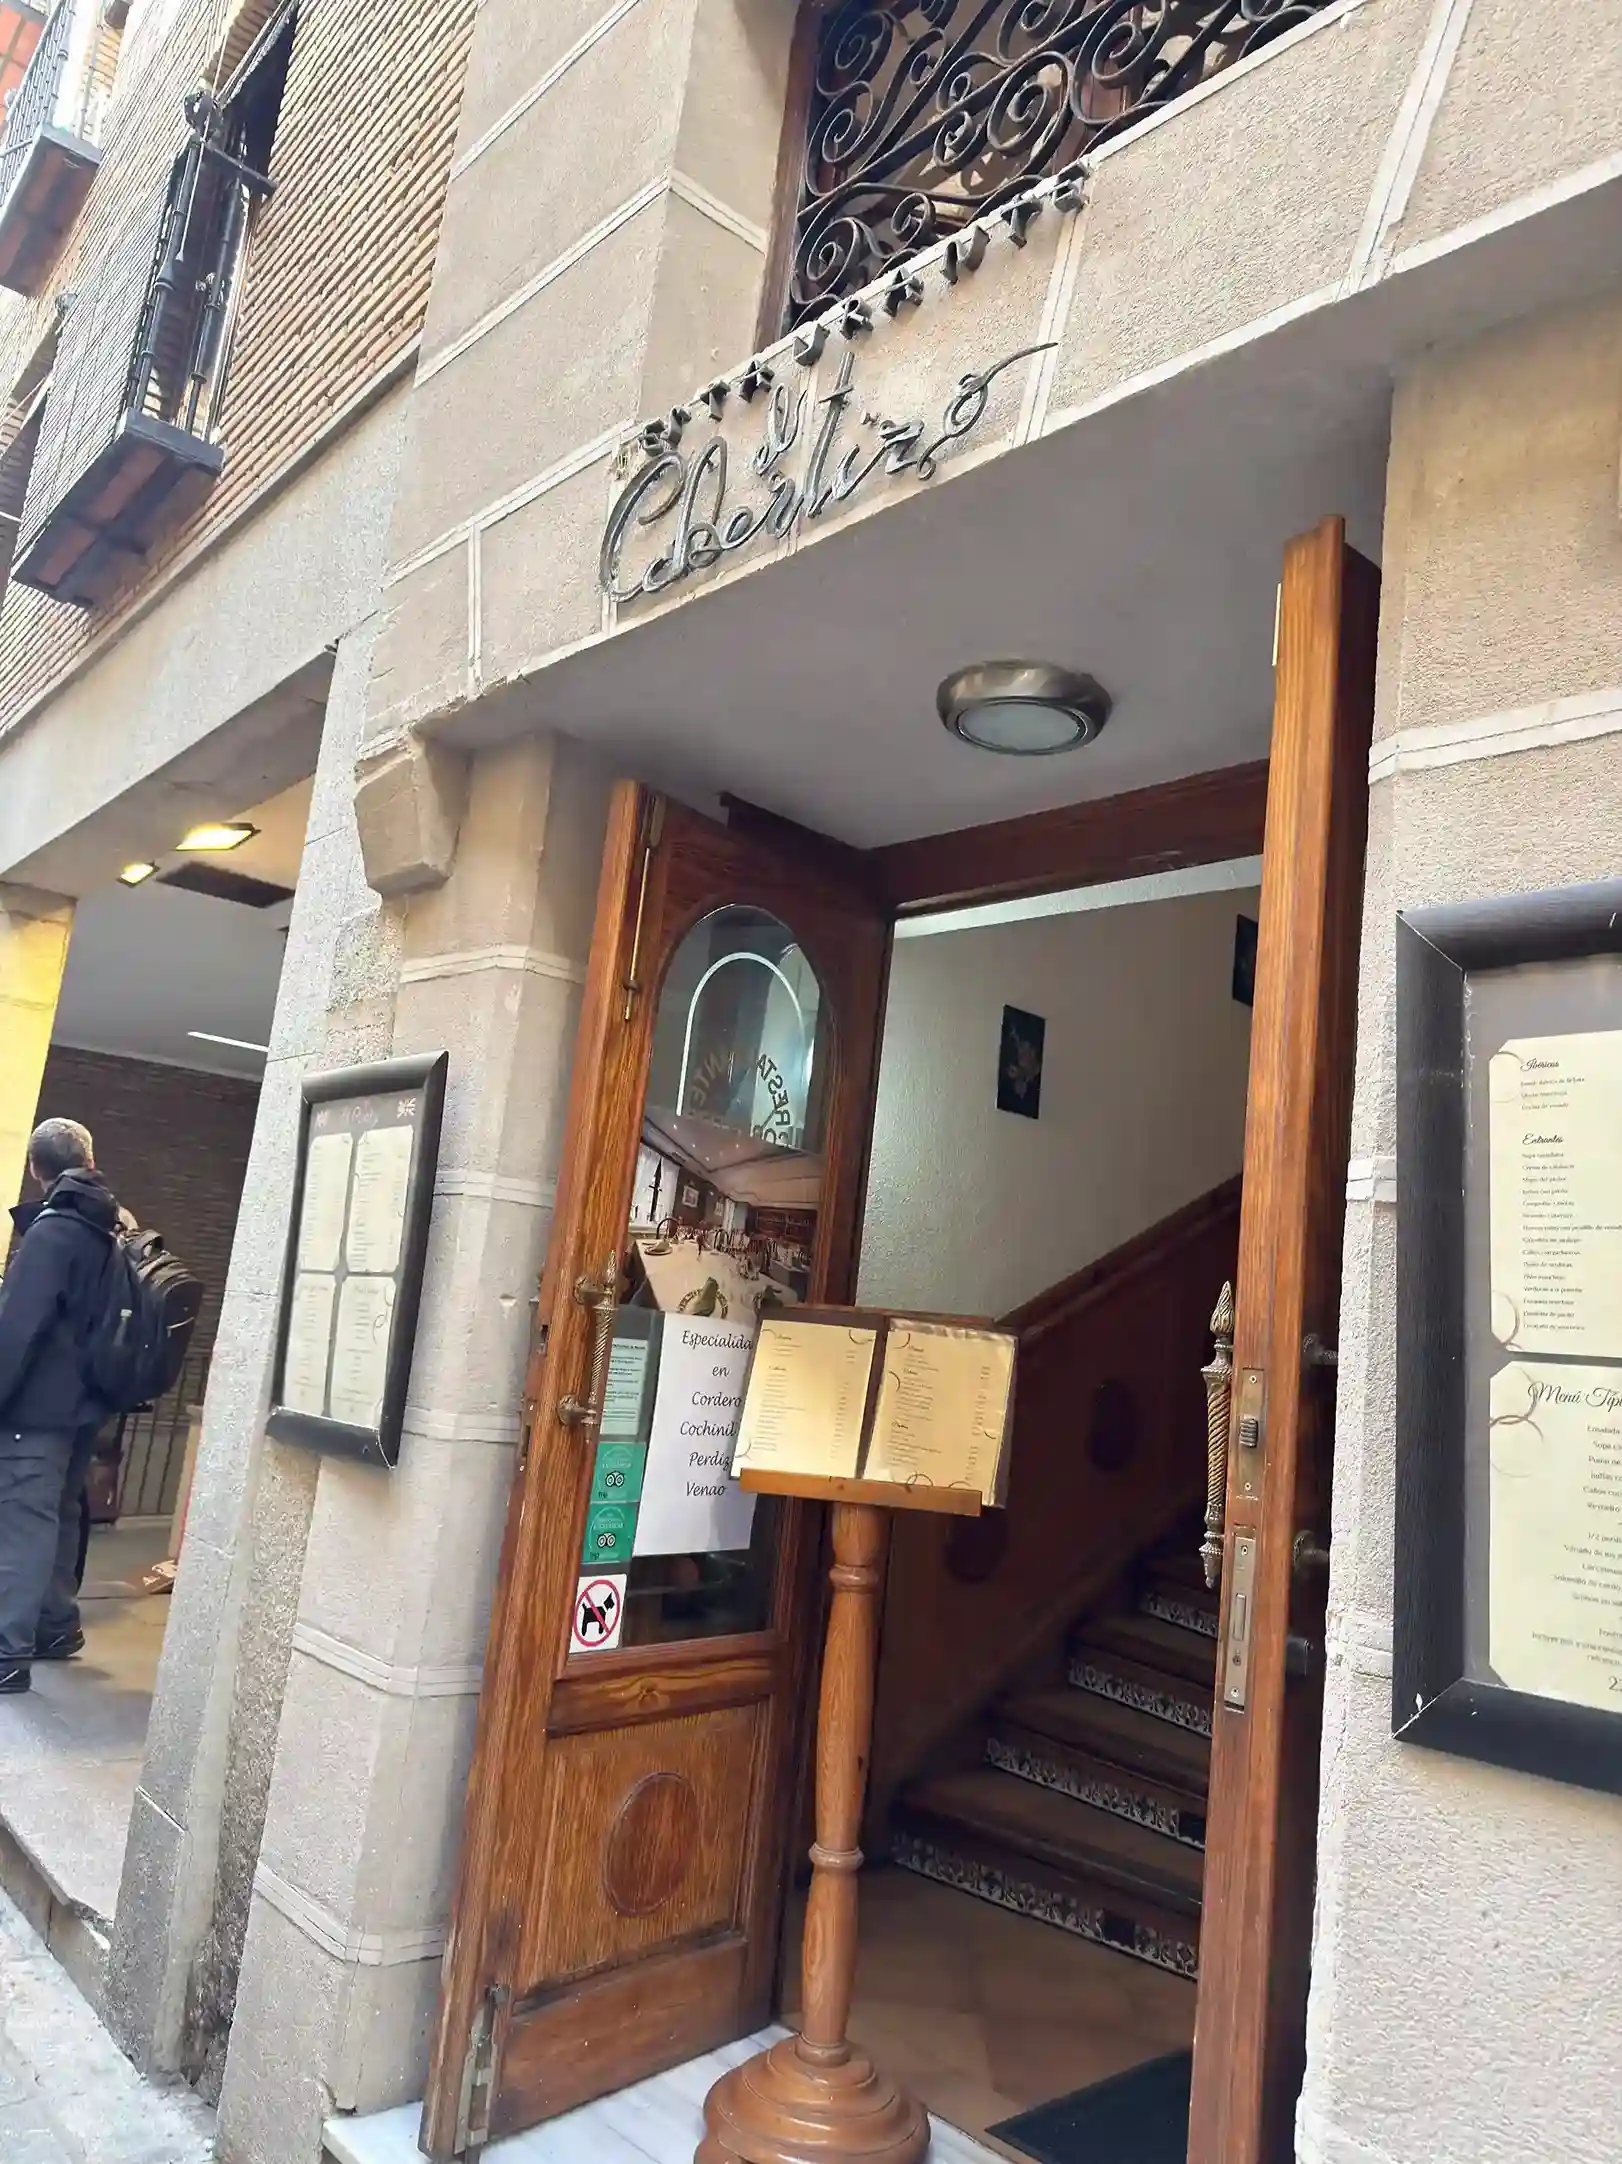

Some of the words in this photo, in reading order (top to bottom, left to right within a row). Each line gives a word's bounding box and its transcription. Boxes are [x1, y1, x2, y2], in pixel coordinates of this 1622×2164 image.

[1522, 1132, 1564, 1146] Entrantes
[712, 1366, 730, 1378] en
[692, 1391, 742, 1409] Cordero
[1527, 1381, 1583, 1405] Menú
[680, 1420, 739, 1437] Cochinil
[689, 1451, 731, 1472] Perdiz
[686, 1481, 727, 1497] Venao
